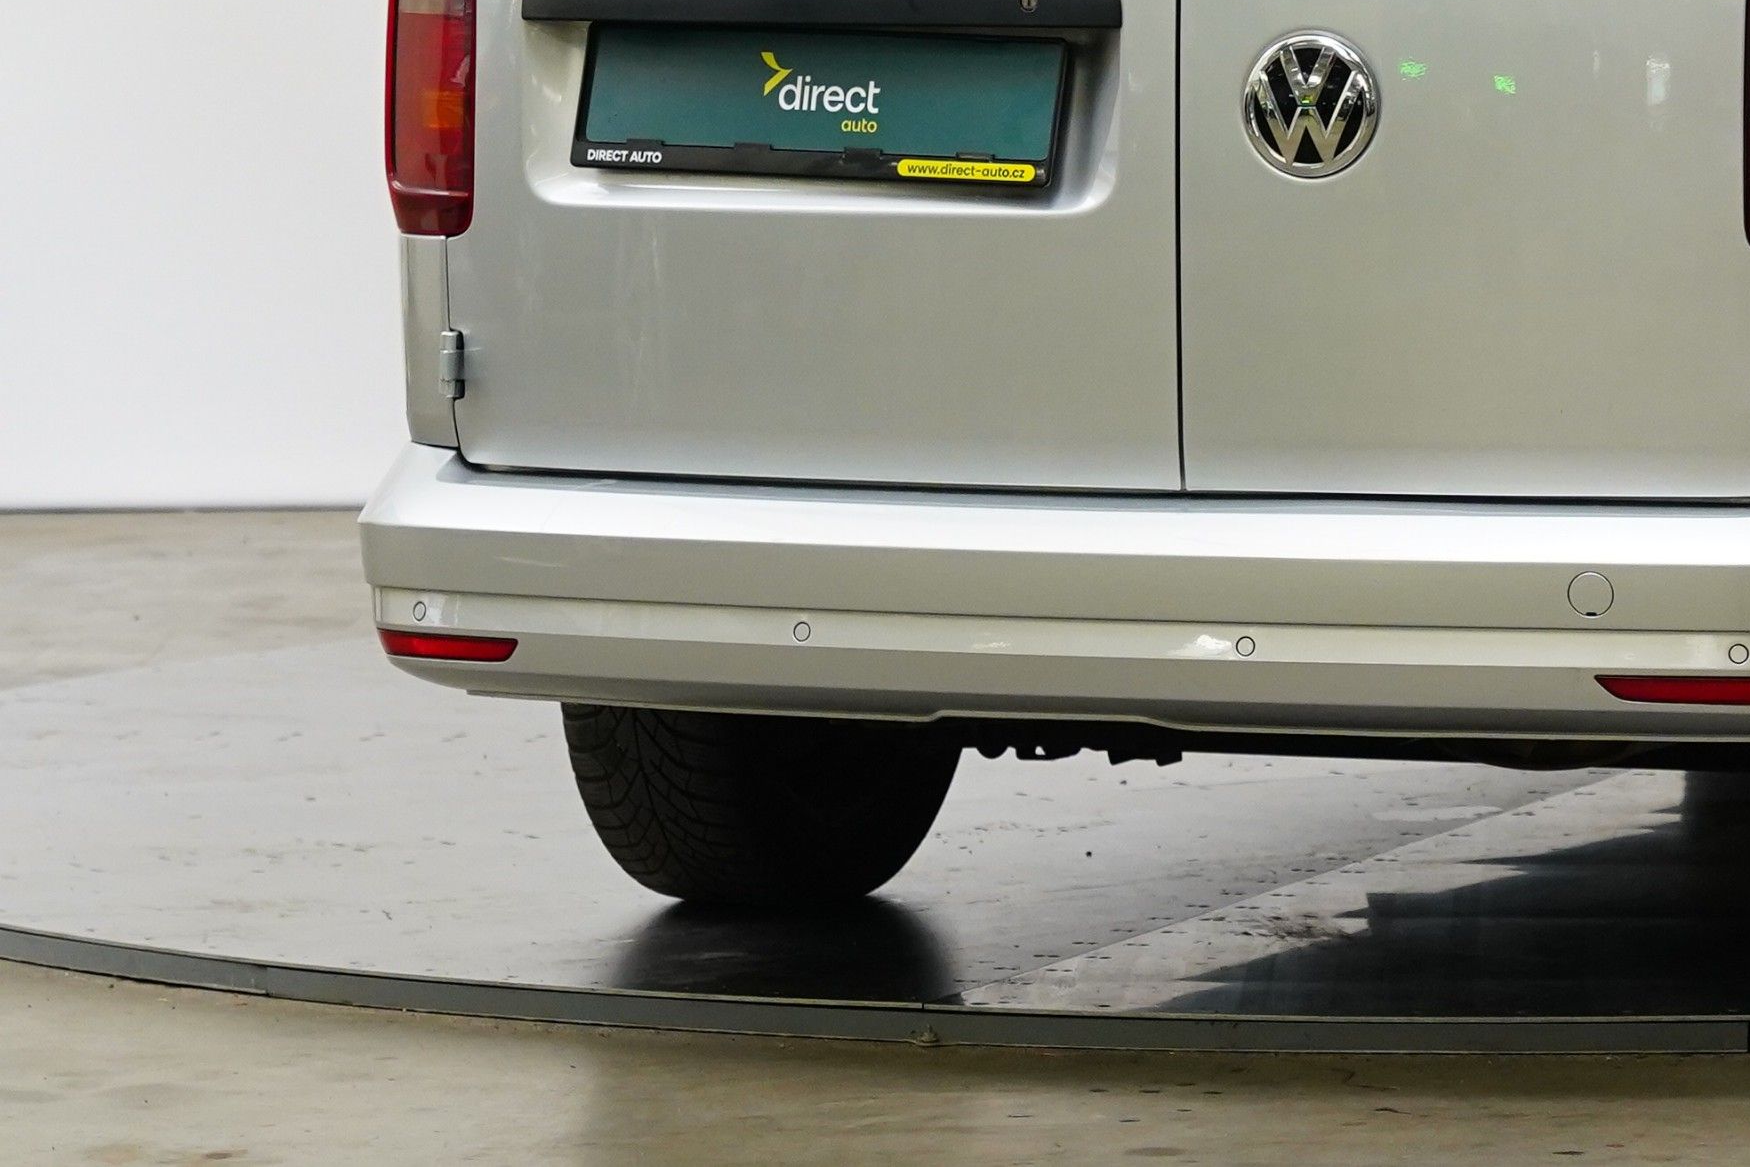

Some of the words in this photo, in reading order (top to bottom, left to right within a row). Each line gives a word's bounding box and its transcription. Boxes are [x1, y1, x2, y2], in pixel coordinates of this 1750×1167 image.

[778, 75, 881, 114] direct
[1250, 42, 1370, 170] VW
[841, 118, 878, 133] auto
[586, 148, 629, 163] DIRECT
[629, 150, 663, 164] AUTO
[906, 163, 1026, 179] www.direct-auto.cz
